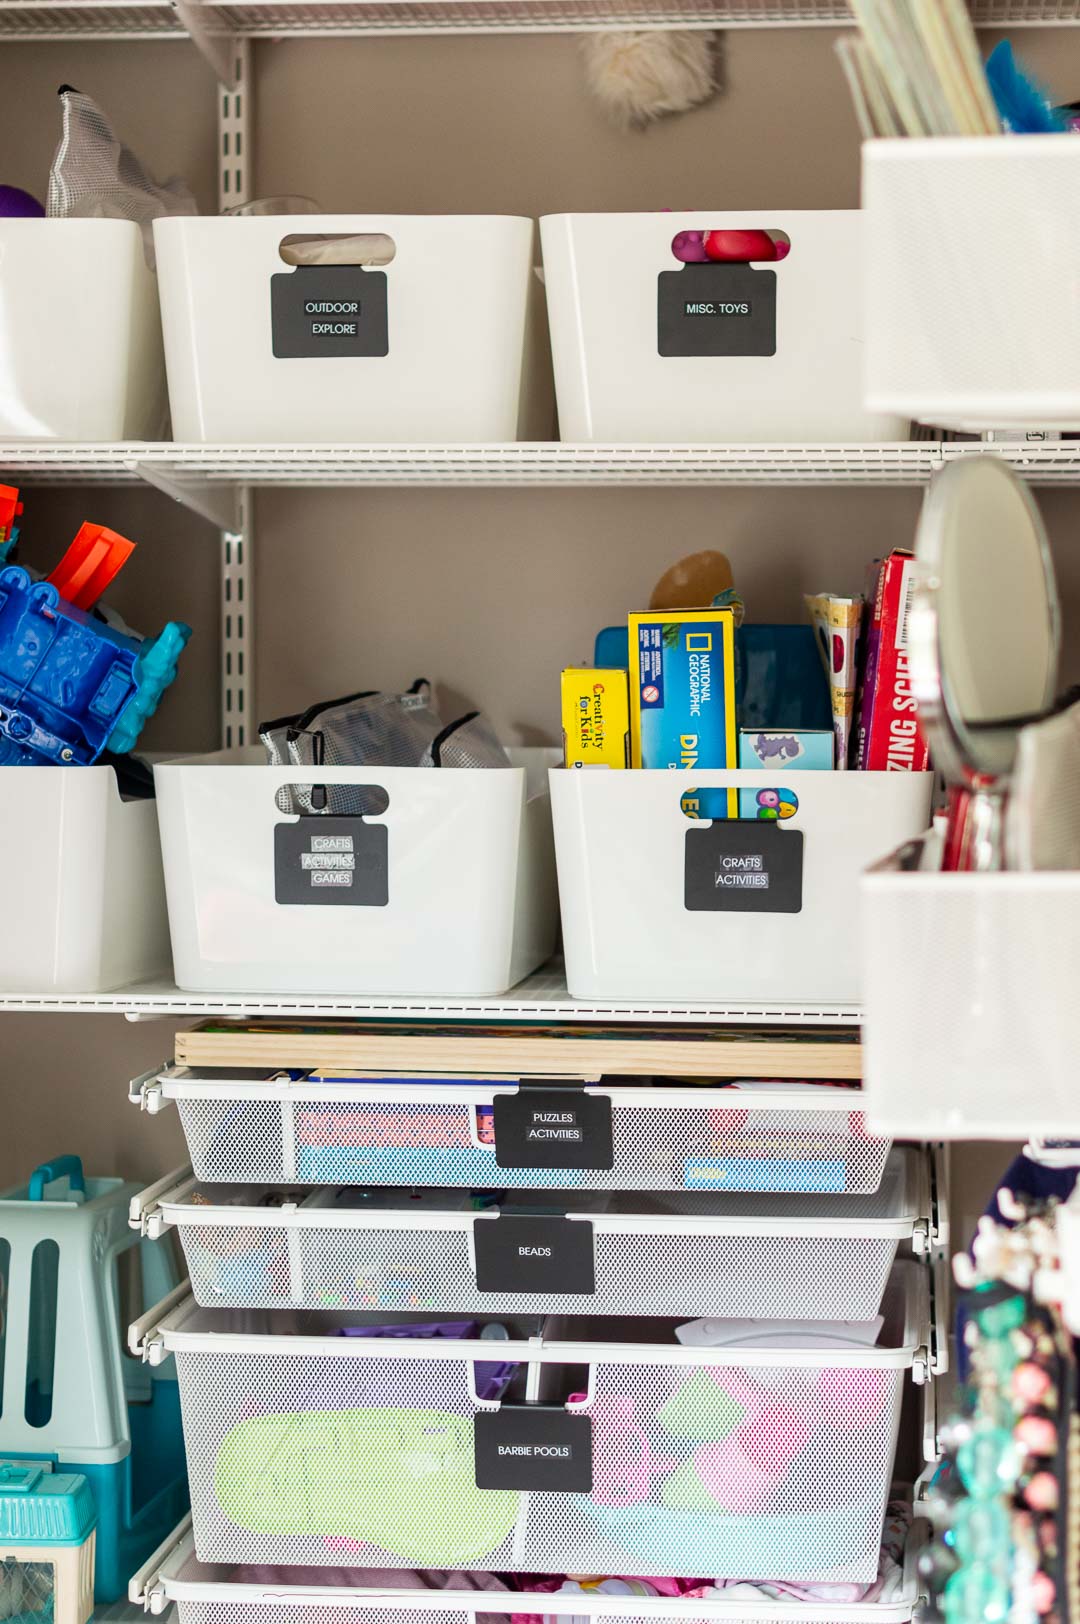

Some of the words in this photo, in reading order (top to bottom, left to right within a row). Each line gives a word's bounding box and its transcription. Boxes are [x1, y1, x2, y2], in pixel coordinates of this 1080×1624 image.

[305, 302, 358, 313] OUTDOOR
[686, 303, 716, 314] MISC.
[719, 303, 749, 314] TOYS
[312, 323, 356, 334] EXPLORE
[700, 654, 711, 703] NATIONAL
[689, 654, 701, 717] GEOGRAPHIC
[580, 696, 591, 715] for
[593, 683, 606, 750] Creativity
[581, 717, 594, 749] Kids
[680, 734, 698, 769] DIN
[313, 838, 351, 849] CRAFTS
[304, 857, 354, 867] ACTIVITIES
[722, 857, 761, 868] CRAFTS
[313, 873, 350, 884] GAMES
[715, 874, 767, 886] ACTIVITIES
[533, 1113, 573, 1123] PUZZLES
[528, 1129, 580, 1139] ACTIVITIES
[518, 1246, 552, 1257] BEADS
[498, 1445, 532, 1456] BARBIE
[534, 1446, 569, 1457] POOLS
